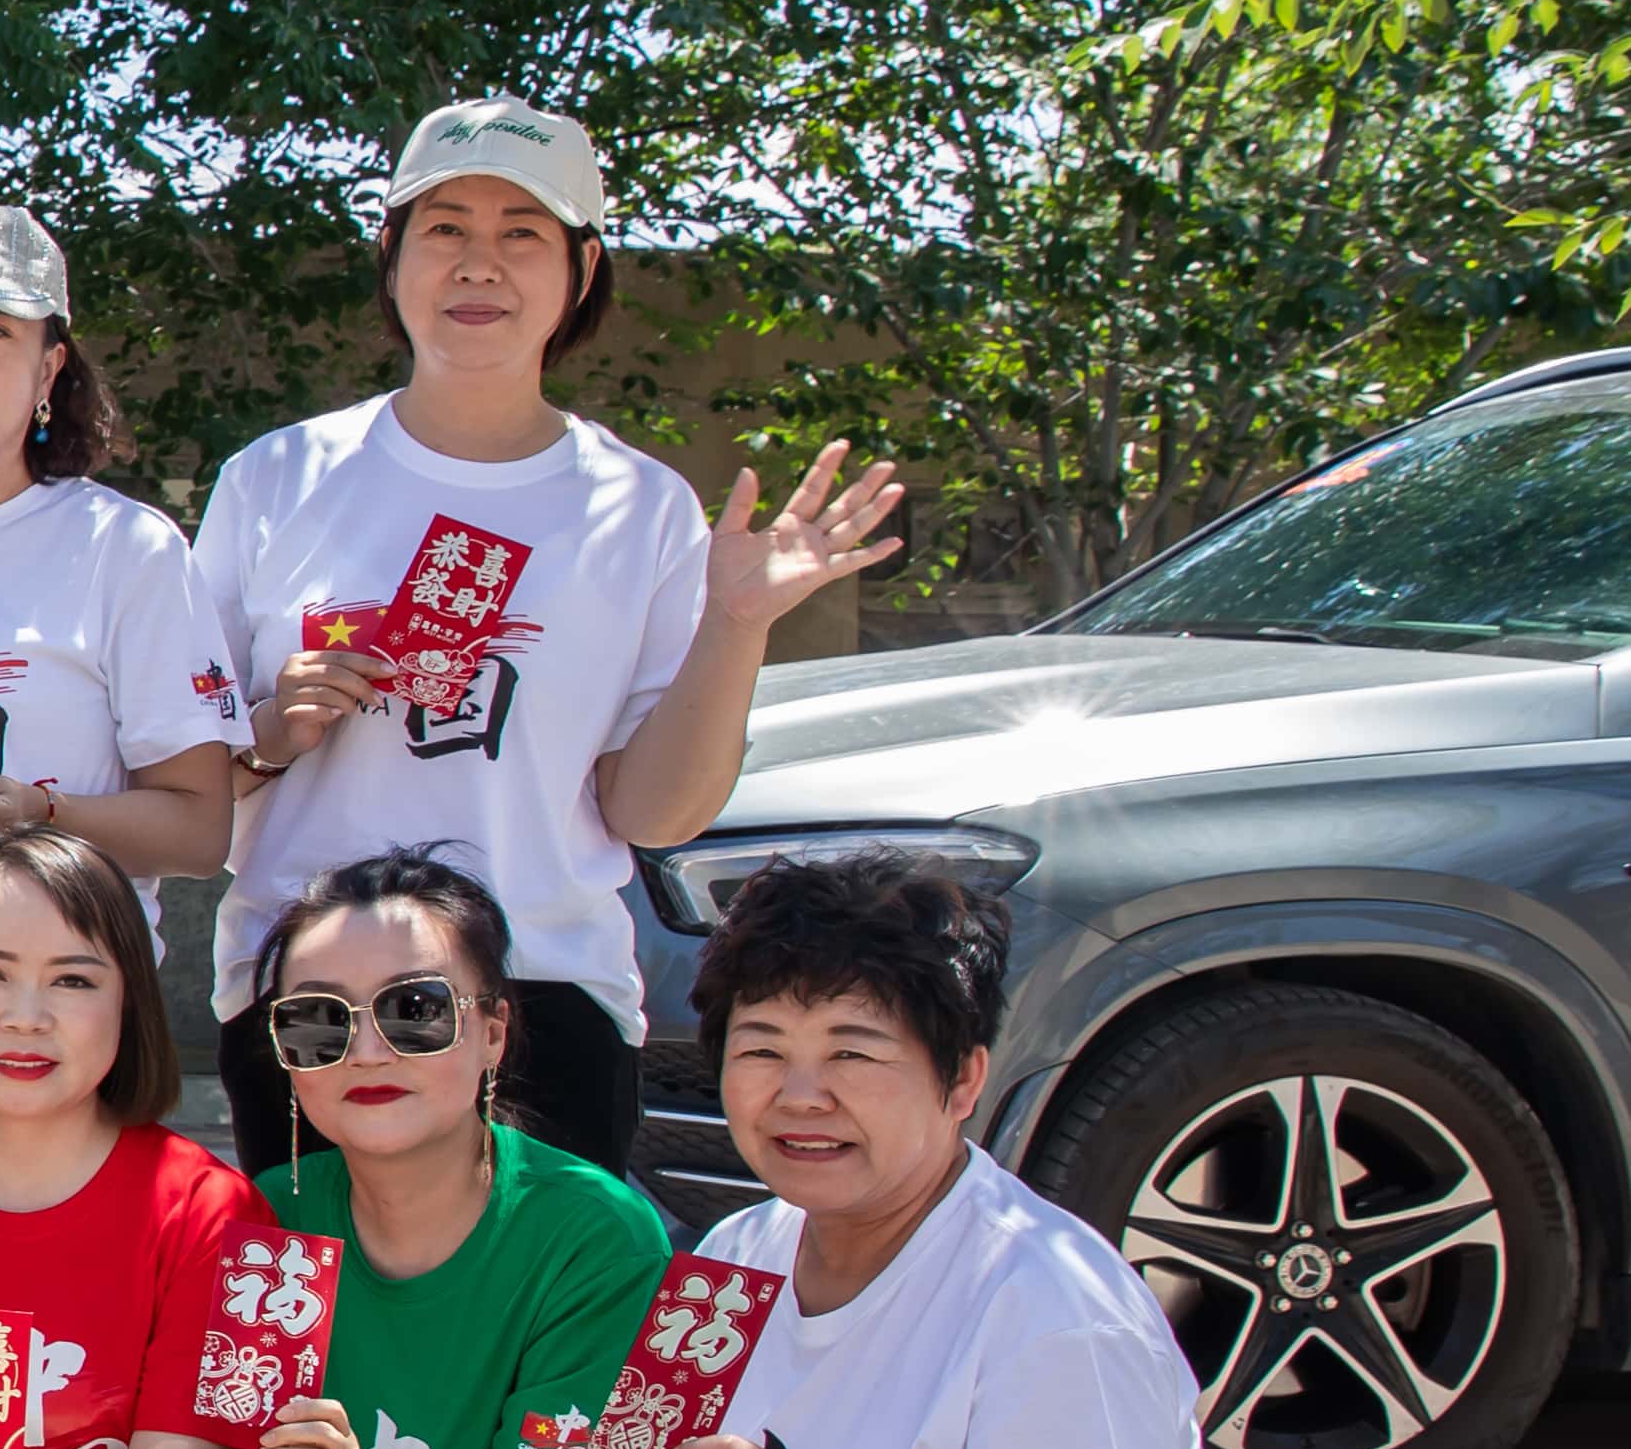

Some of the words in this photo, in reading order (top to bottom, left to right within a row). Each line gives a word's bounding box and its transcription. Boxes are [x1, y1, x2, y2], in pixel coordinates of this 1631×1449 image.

[468, 117, 555, 147] positive
[423, 531, 512, 588] 恭喜
[408, 567, 499, 628] 發財
[206, 658, 237, 721] 中国
[222, 1235, 327, 1339] 福
[646, 1268, 756, 1376] 福
